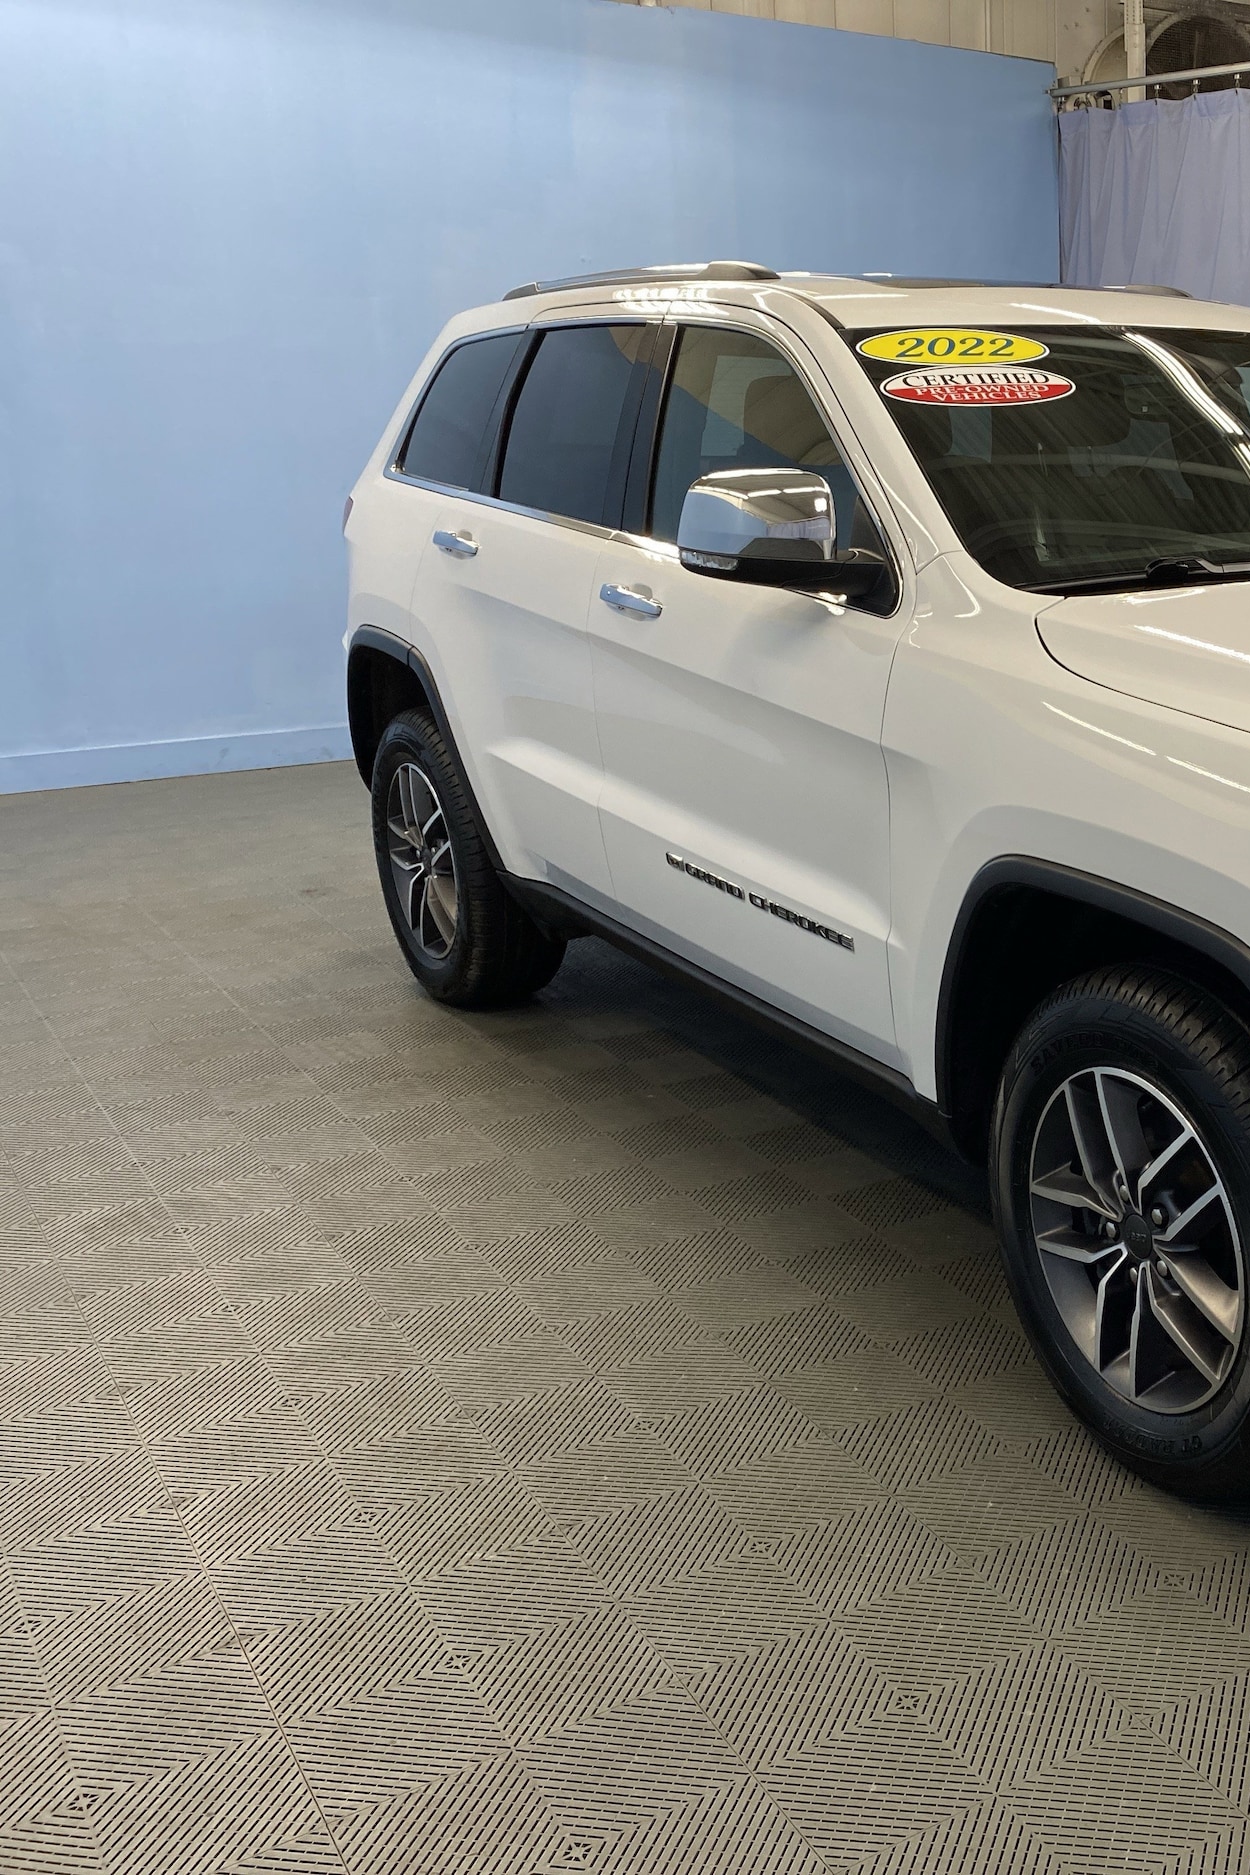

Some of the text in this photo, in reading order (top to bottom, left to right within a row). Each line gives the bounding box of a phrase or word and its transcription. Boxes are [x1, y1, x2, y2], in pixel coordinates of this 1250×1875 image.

[897, 337, 1014, 358] 2022
[903, 373, 1050, 388] CERTIFIED
[915, 384, 1049, 396] PRE-OWNED
[933, 391, 1041, 402] VEHICLES
[748, 891, 854, 952] CHEROKEE
